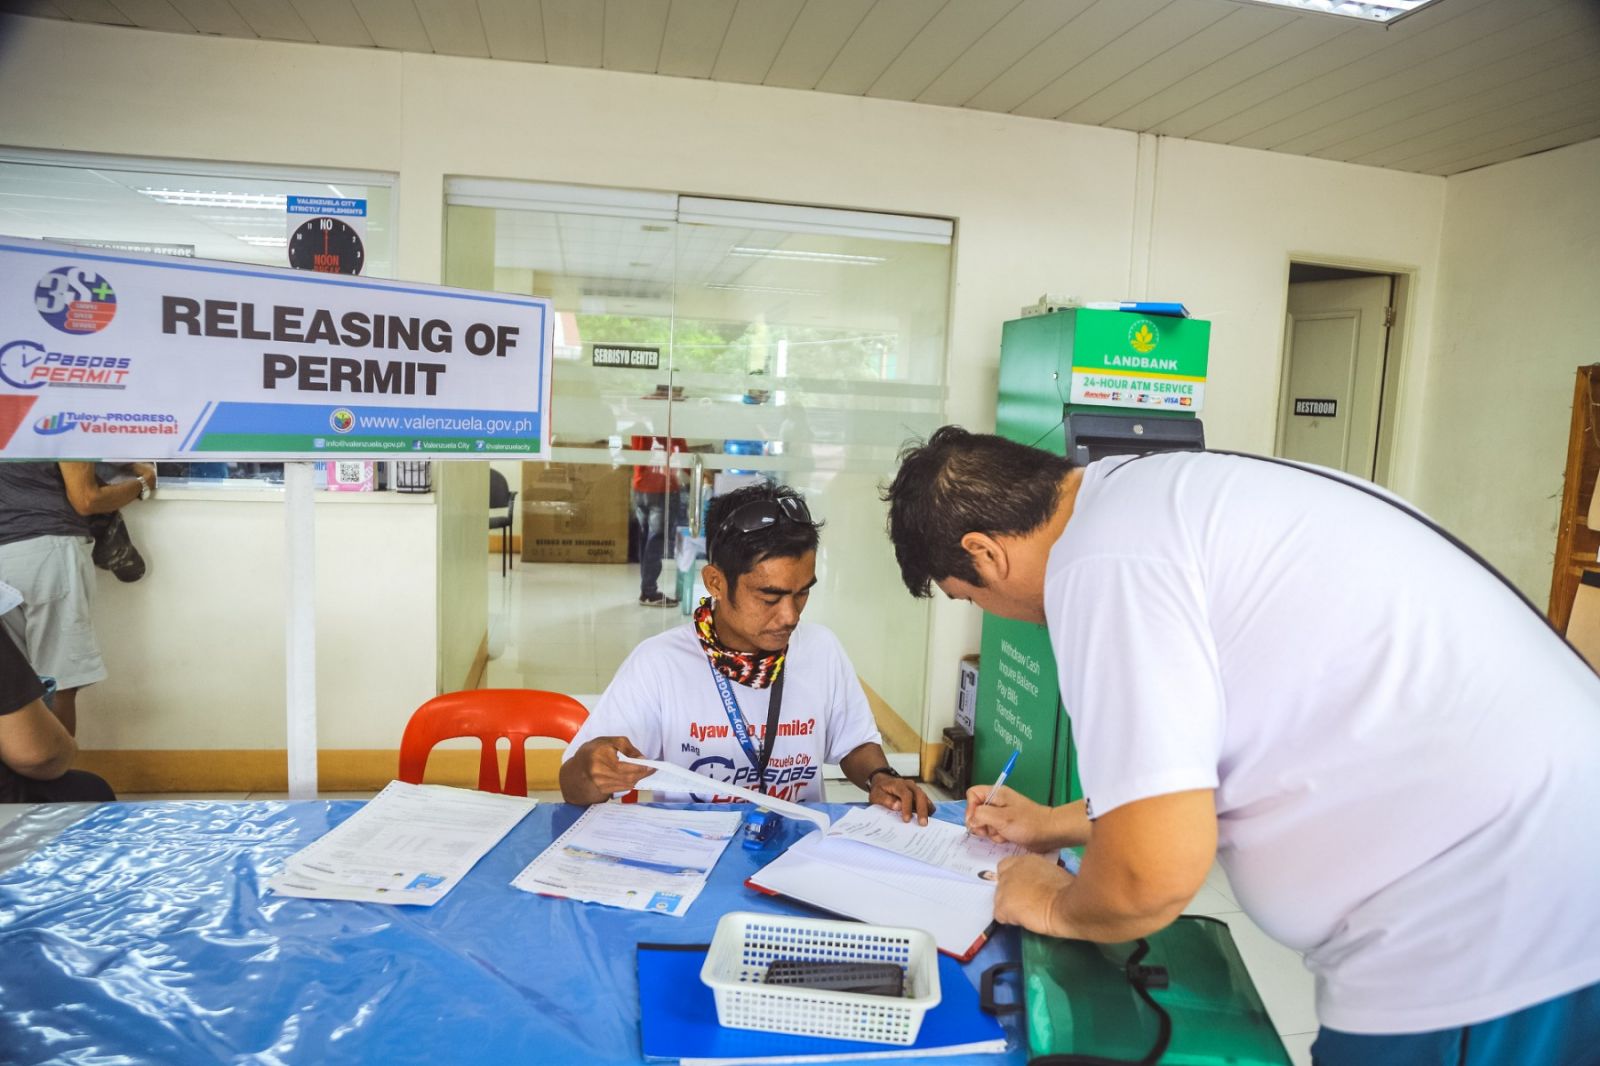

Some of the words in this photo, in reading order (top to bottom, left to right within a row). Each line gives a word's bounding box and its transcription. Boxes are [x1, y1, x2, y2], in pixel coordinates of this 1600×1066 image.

[290, 205, 320, 213] STRICTLY
[297, 198, 339, 206] VALENZUELA
[320, 218, 333, 231] NO
[314, 254, 339, 266] NOON
[161, 295, 453, 353] RELEASING
[464, 322, 520, 357] OF
[44, 352, 131, 368] Paspas
[594, 348, 630, 364] SERBISYO
[631, 350, 658, 366] CENTER
[1104, 354, 1178, 370] LANDBANK
[31, 366, 129, 384] PERMIT
[262, 353, 447, 396] PERMIT
[1083, 377, 1128, 389] 24-HOUR
[1131, 381, 1151, 391] ATM
[1153, 382, 1193, 394] SERVICE
[1296, 401, 1335, 414] RESTROOM
[80, 422, 178, 434] Valenzuela!
[360, 413, 533, 434] www.valenzuela.gov.ph
[326, 438, 406, 448] info@valenzuela.gov.ph
[424, 441, 456, 449] Valenzuela
[458, 441, 470, 451] City
[1001, 638, 1026, 666] Withdraw
[1025, 655, 1040, 675] Cash
[1017, 671, 1039, 697] Balance
[997, 680, 1008, 698] Pay
[1007, 686, 1018, 706] Bills
[690, 722, 729, 742] Ayaw
[761, 718, 815, 742] pmila?
[1016, 716, 1033, 740] Funds
[795, 753, 811, 766] City
